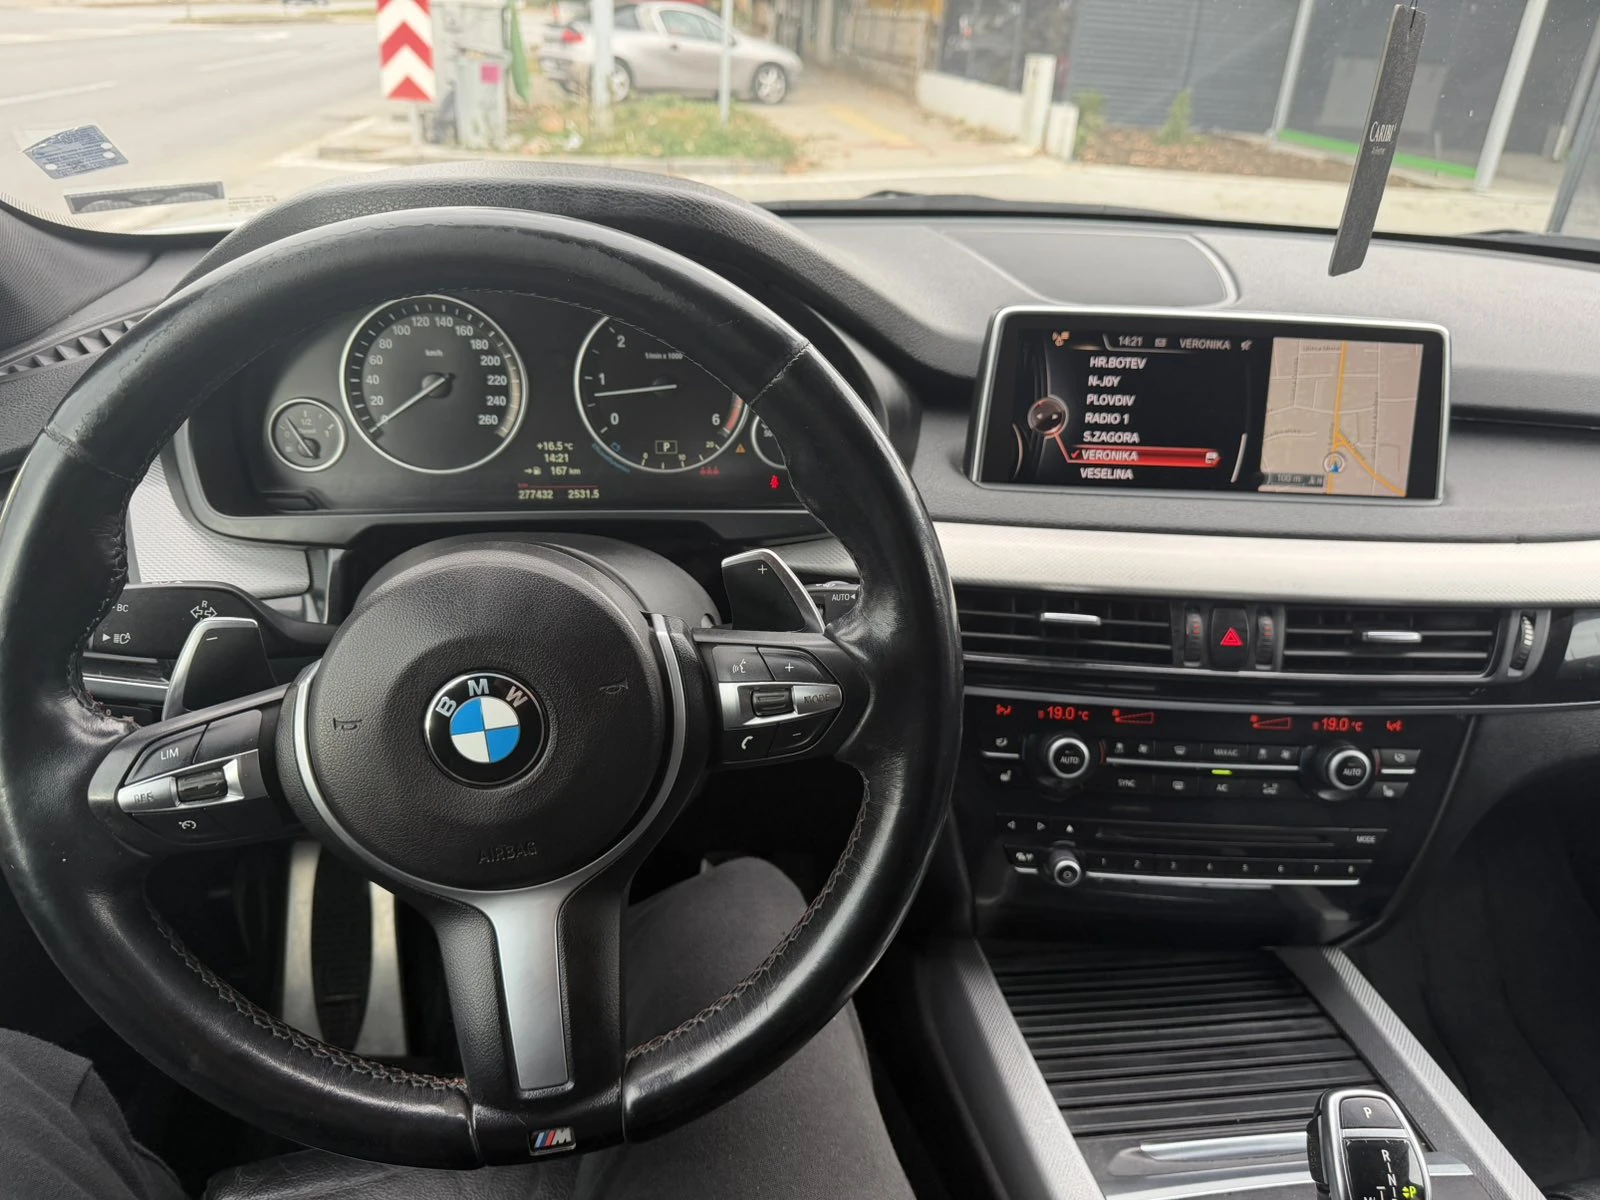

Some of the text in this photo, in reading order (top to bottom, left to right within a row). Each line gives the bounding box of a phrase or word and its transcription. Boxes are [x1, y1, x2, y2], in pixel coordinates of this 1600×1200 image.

[411, 316, 430, 327] 120
[435, 316, 453, 327] 140
[393, 325, 411, 336] 100
[456, 325, 474, 336] 160
[379, 338, 392, 349] 80
[471, 339, 489, 350] 180
[617, 335, 626, 348] 2
[1118, 336, 1231, 350] 14:21 VERONIKA
[370, 354, 383, 365] 60
[480, 355, 500, 366] 200
[1089, 356, 1147, 369] HR.BOTEV
[366, 375, 380, 385] 40
[487, 375, 507, 386] 220
[599, 373, 606, 385] 1
[370, 395, 384, 406] 20
[486, 395, 507, 406] 240
[1086, 394, 1136, 406] PLOVDIV
[478, 414, 498, 425] 260
[610, 412, 619, 425] 0
[711, 413, 720, 426] 6
[1084, 412, 1130, 424] RADIO 1
[1083, 431, 1140, 444] S.ZAGORA
[537, 441, 563, 451] +16.5
[663, 442, 670, 452] P
[544, 453, 569, 462] 14:21
[1081, 449, 1139, 461] VERONIKA
[551, 466, 581, 475] 167 km
[1080, 468, 1133, 480] VESELINA
[518, 489, 554, 500] 277432
[567, 489, 599, 499] 2531.5
[832, 593, 850, 601] AUTO
[116, 603, 129, 613] BC
[201, 600, 208, 608] R
[435, 678, 529, 718] BMW
[1048, 706, 1075, 720] 19.0
[1322, 717, 1348, 731] 19.0
[160, 748, 179, 761] LIM
[1060, 756, 1079, 764] AUTO
[1343, 768, 1361, 777] AUTO
[1356, 835, 1376, 844] MODE
[478, 842, 538, 864] AIRBAG
[1363, 1107, 1372, 1119] P
[1381, 1149, 1391, 1162] R
[1387, 1173, 1397, 1187] N
